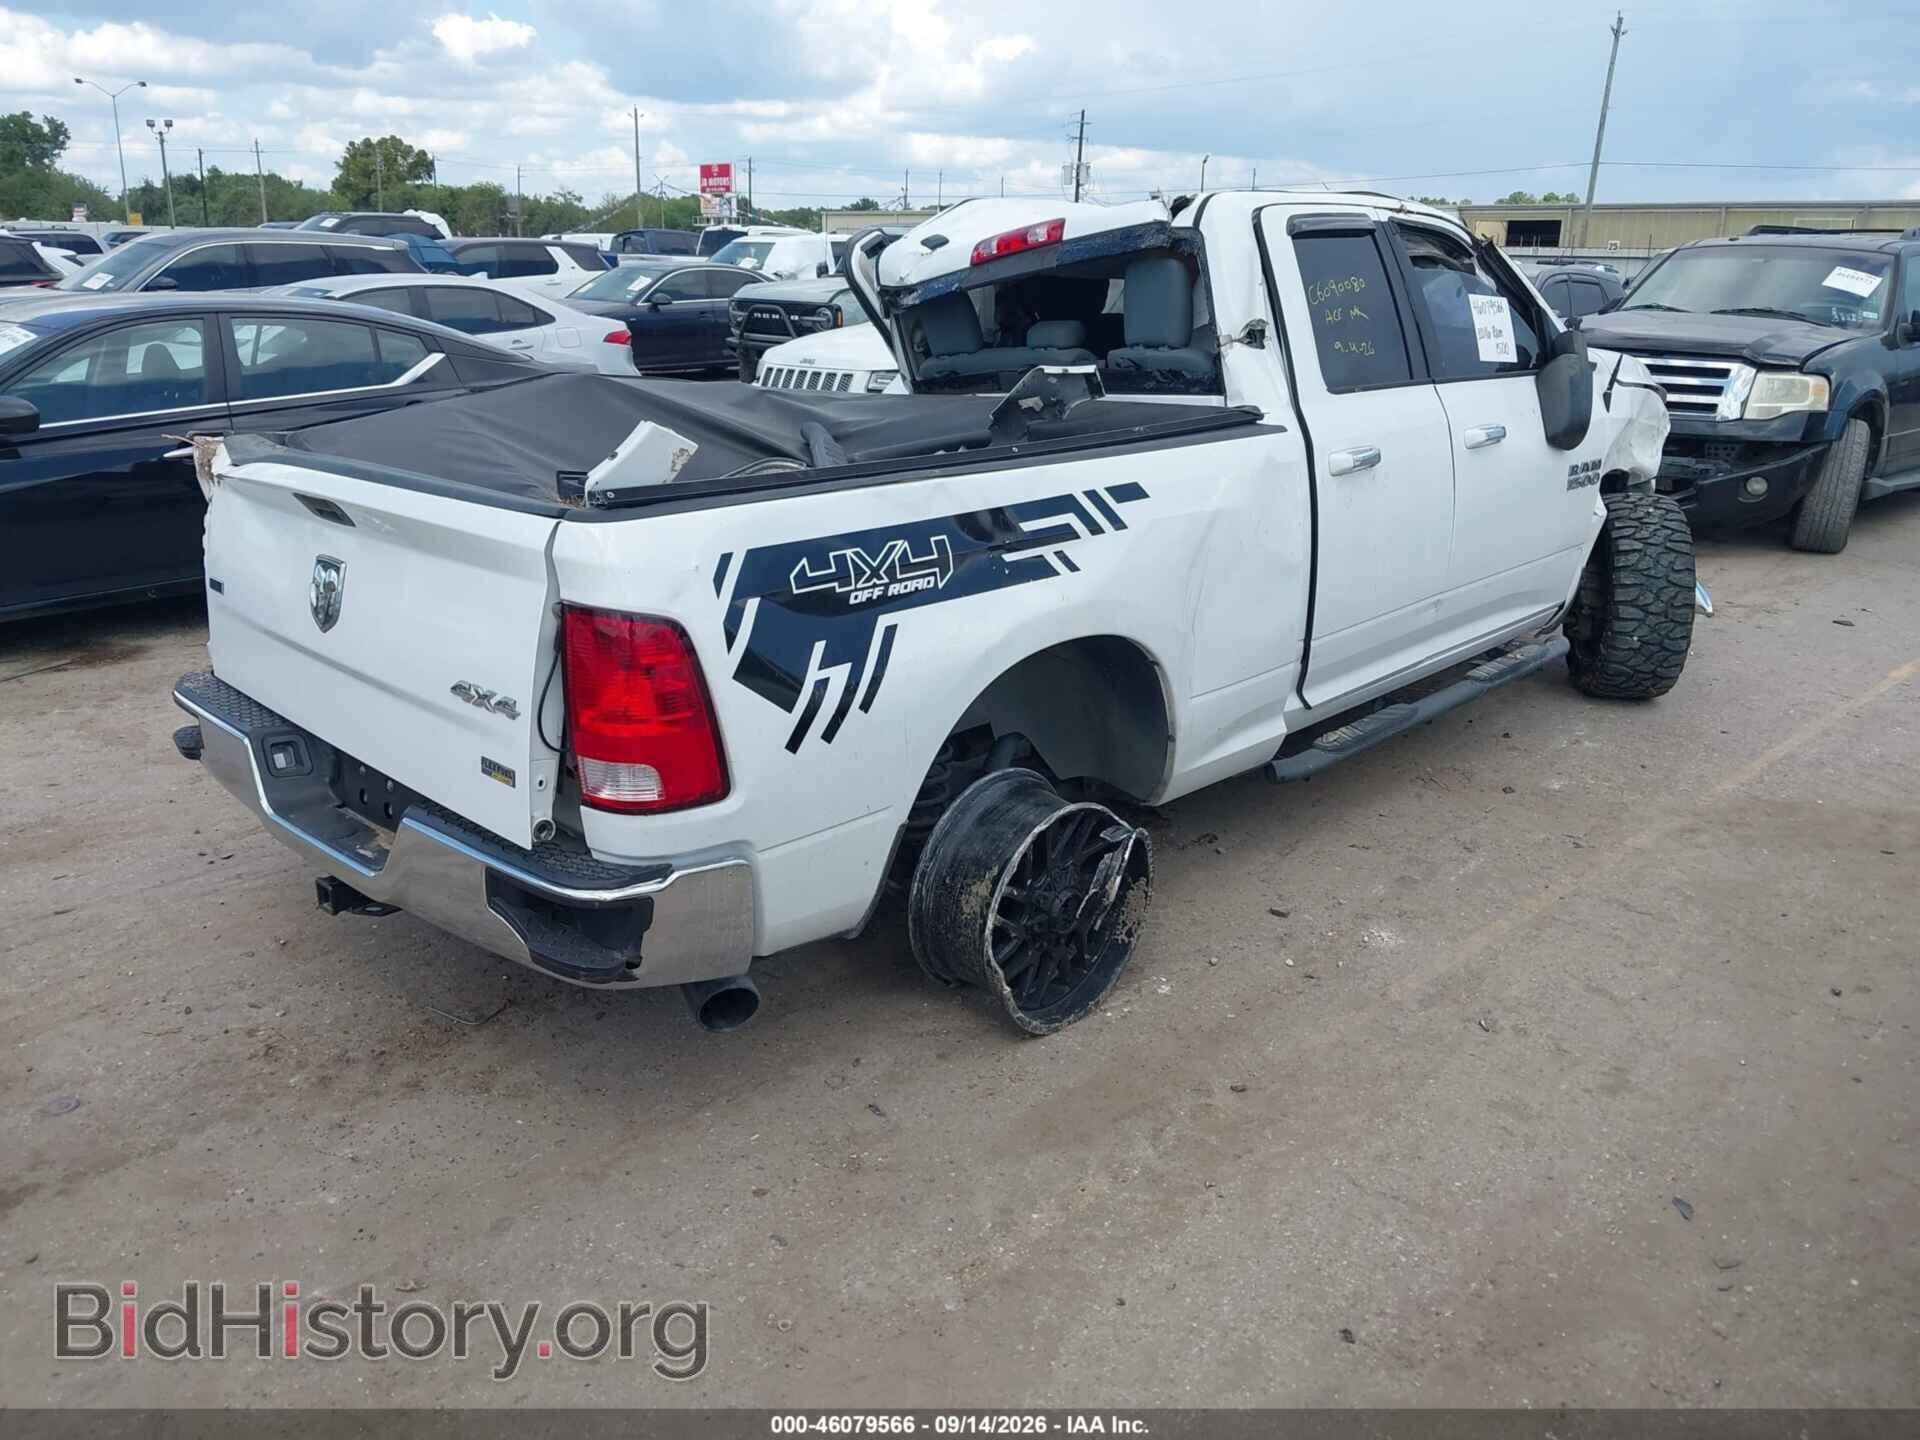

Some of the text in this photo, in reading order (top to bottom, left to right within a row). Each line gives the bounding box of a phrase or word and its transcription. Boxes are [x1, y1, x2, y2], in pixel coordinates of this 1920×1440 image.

[1568, 459, 1602, 477] RAM
[1567, 472, 1600, 491] 1500
[849, 576, 936, 605] OFF ROAD
